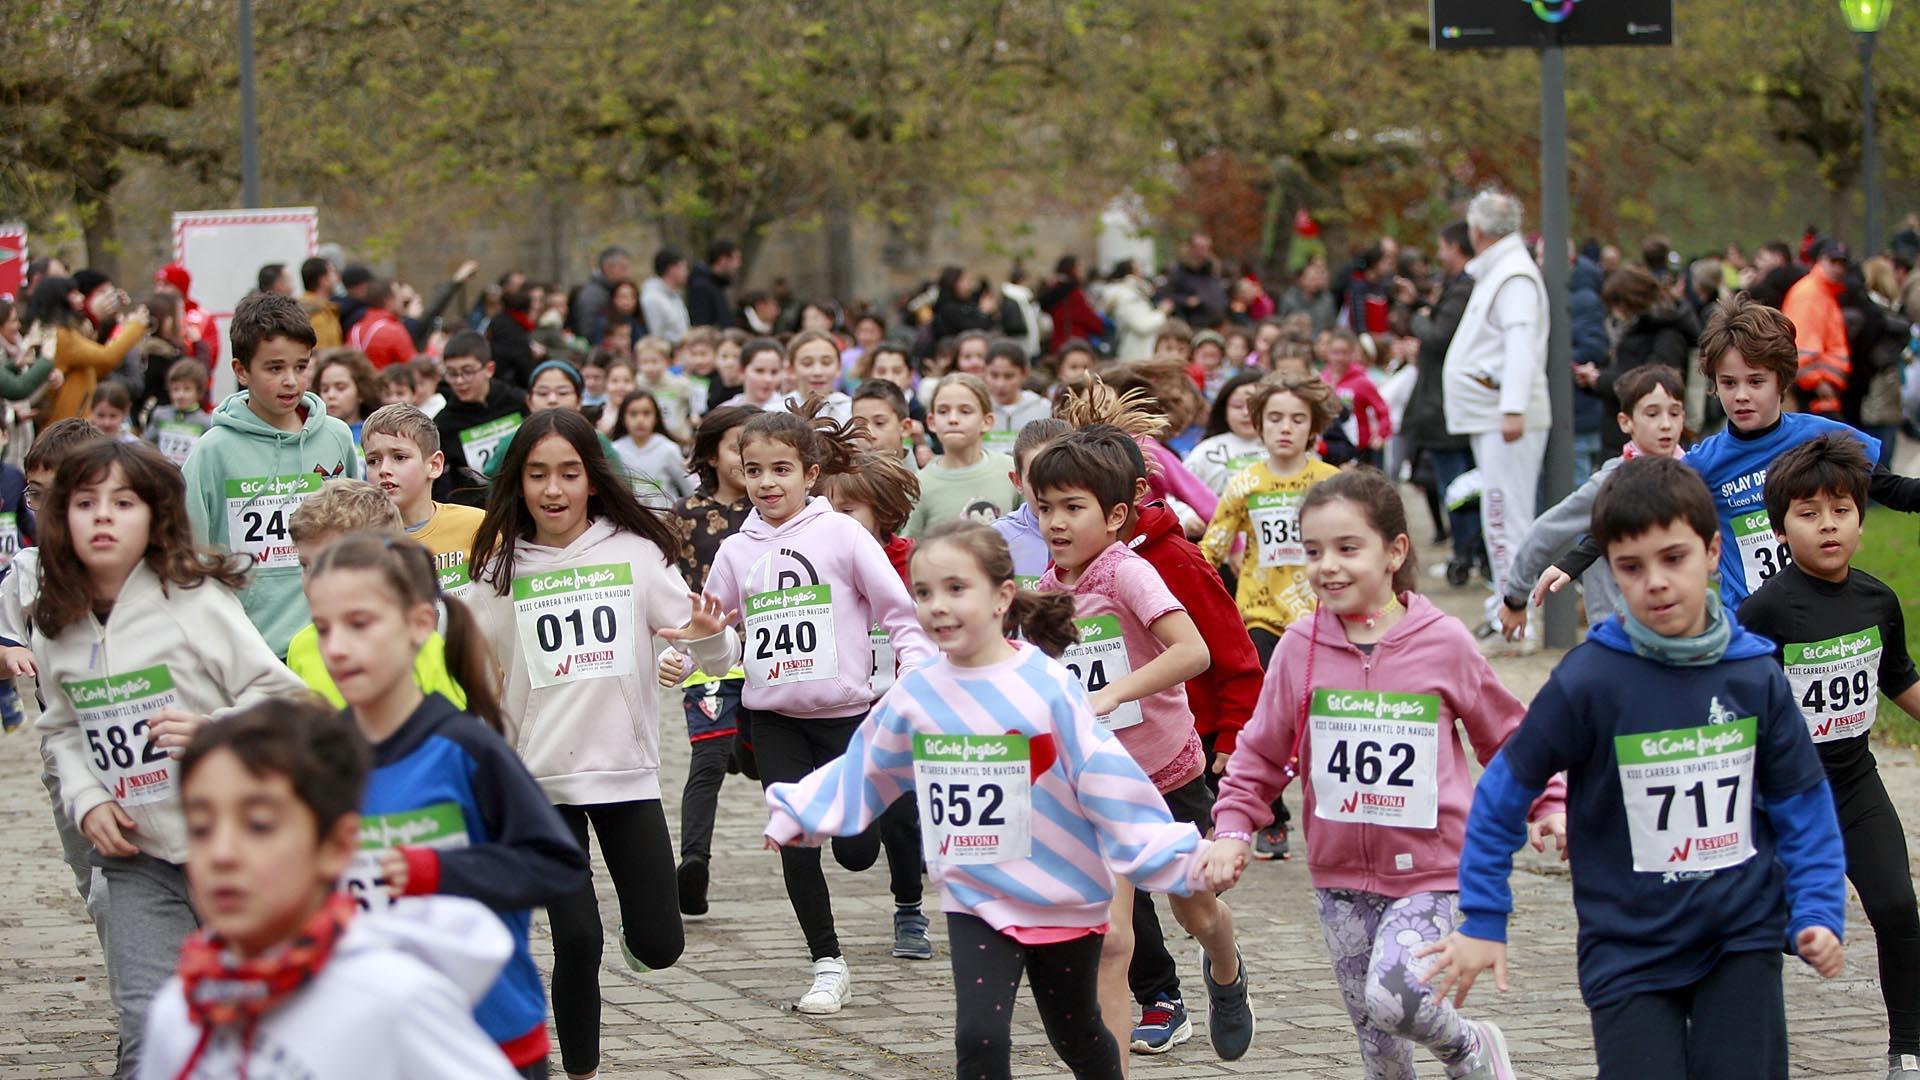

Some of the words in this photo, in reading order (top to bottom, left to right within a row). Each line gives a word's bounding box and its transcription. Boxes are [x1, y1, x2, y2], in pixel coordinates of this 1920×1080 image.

[1721, 475, 1751, 498] SPLAY
[531, 579, 545, 592] El
[544, 574, 574, 588] Corte
[574, 569, 615, 590] Inglés
[520, 602, 533, 612] XIII
[534, 599, 562, 611] CARRERA
[564, 595, 593, 605] INFANTIL
[595, 592, 604, 601] DE
[605, 589, 631, 598] NAVIDAD
[752, 598, 762, 610] El
[761, 595, 783, 608] Corte
[782, 590, 817, 608] Inglés
[798, 609, 805, 617] DE
[807, 607, 830, 616] NAVIDAD
[537, 605, 617, 652] 010
[756, 620, 817, 660] 240
[575, 651, 613, 664] ASVONA
[1085, 646, 1093, 655] DE
[1094, 641, 1121, 654] NAVIDAD
[1802, 646, 1815, 660] El
[1815, 644, 1840, 658] Corte
[1839, 636, 1871, 658] Inglés
[1803, 665, 1830, 675] CARRERA
[1802, 670, 1869, 713] 499
[131, 705, 142, 714] DE
[143, 694, 175, 710] NAVIDAD
[1327, 694, 1342, 712] El
[1342, 695, 1376, 713] Corte
[1375, 693, 1424, 719] Inglés
[1329, 721, 1357, 732] CARRERA
[1360, 723, 1394, 735] INFANTIL
[1396, 725, 1406, 735] DE
[87, 719, 169, 771] 582
[934, 739, 963, 756] Corte
[961, 736, 1009, 761] Inglés
[1641, 738, 1659, 757] El
[1659, 737, 1698, 754] Corte
[1696, 727, 1745, 757] Inglés
[951, 766, 980, 776] INFANTIL
[983, 768, 992, 776] DE
[993, 766, 1026, 776] NAVIDAD
[1327, 740, 1416, 787] 462
[1645, 766, 1680, 779] CARRERA
[1683, 761, 1719, 774] INFANTIL
[929, 783, 1006, 827] 652
[1361, 793, 1405, 808] ASVONA
[1646, 775, 1740, 832] 717
[954, 835, 999, 847] ASVONA
